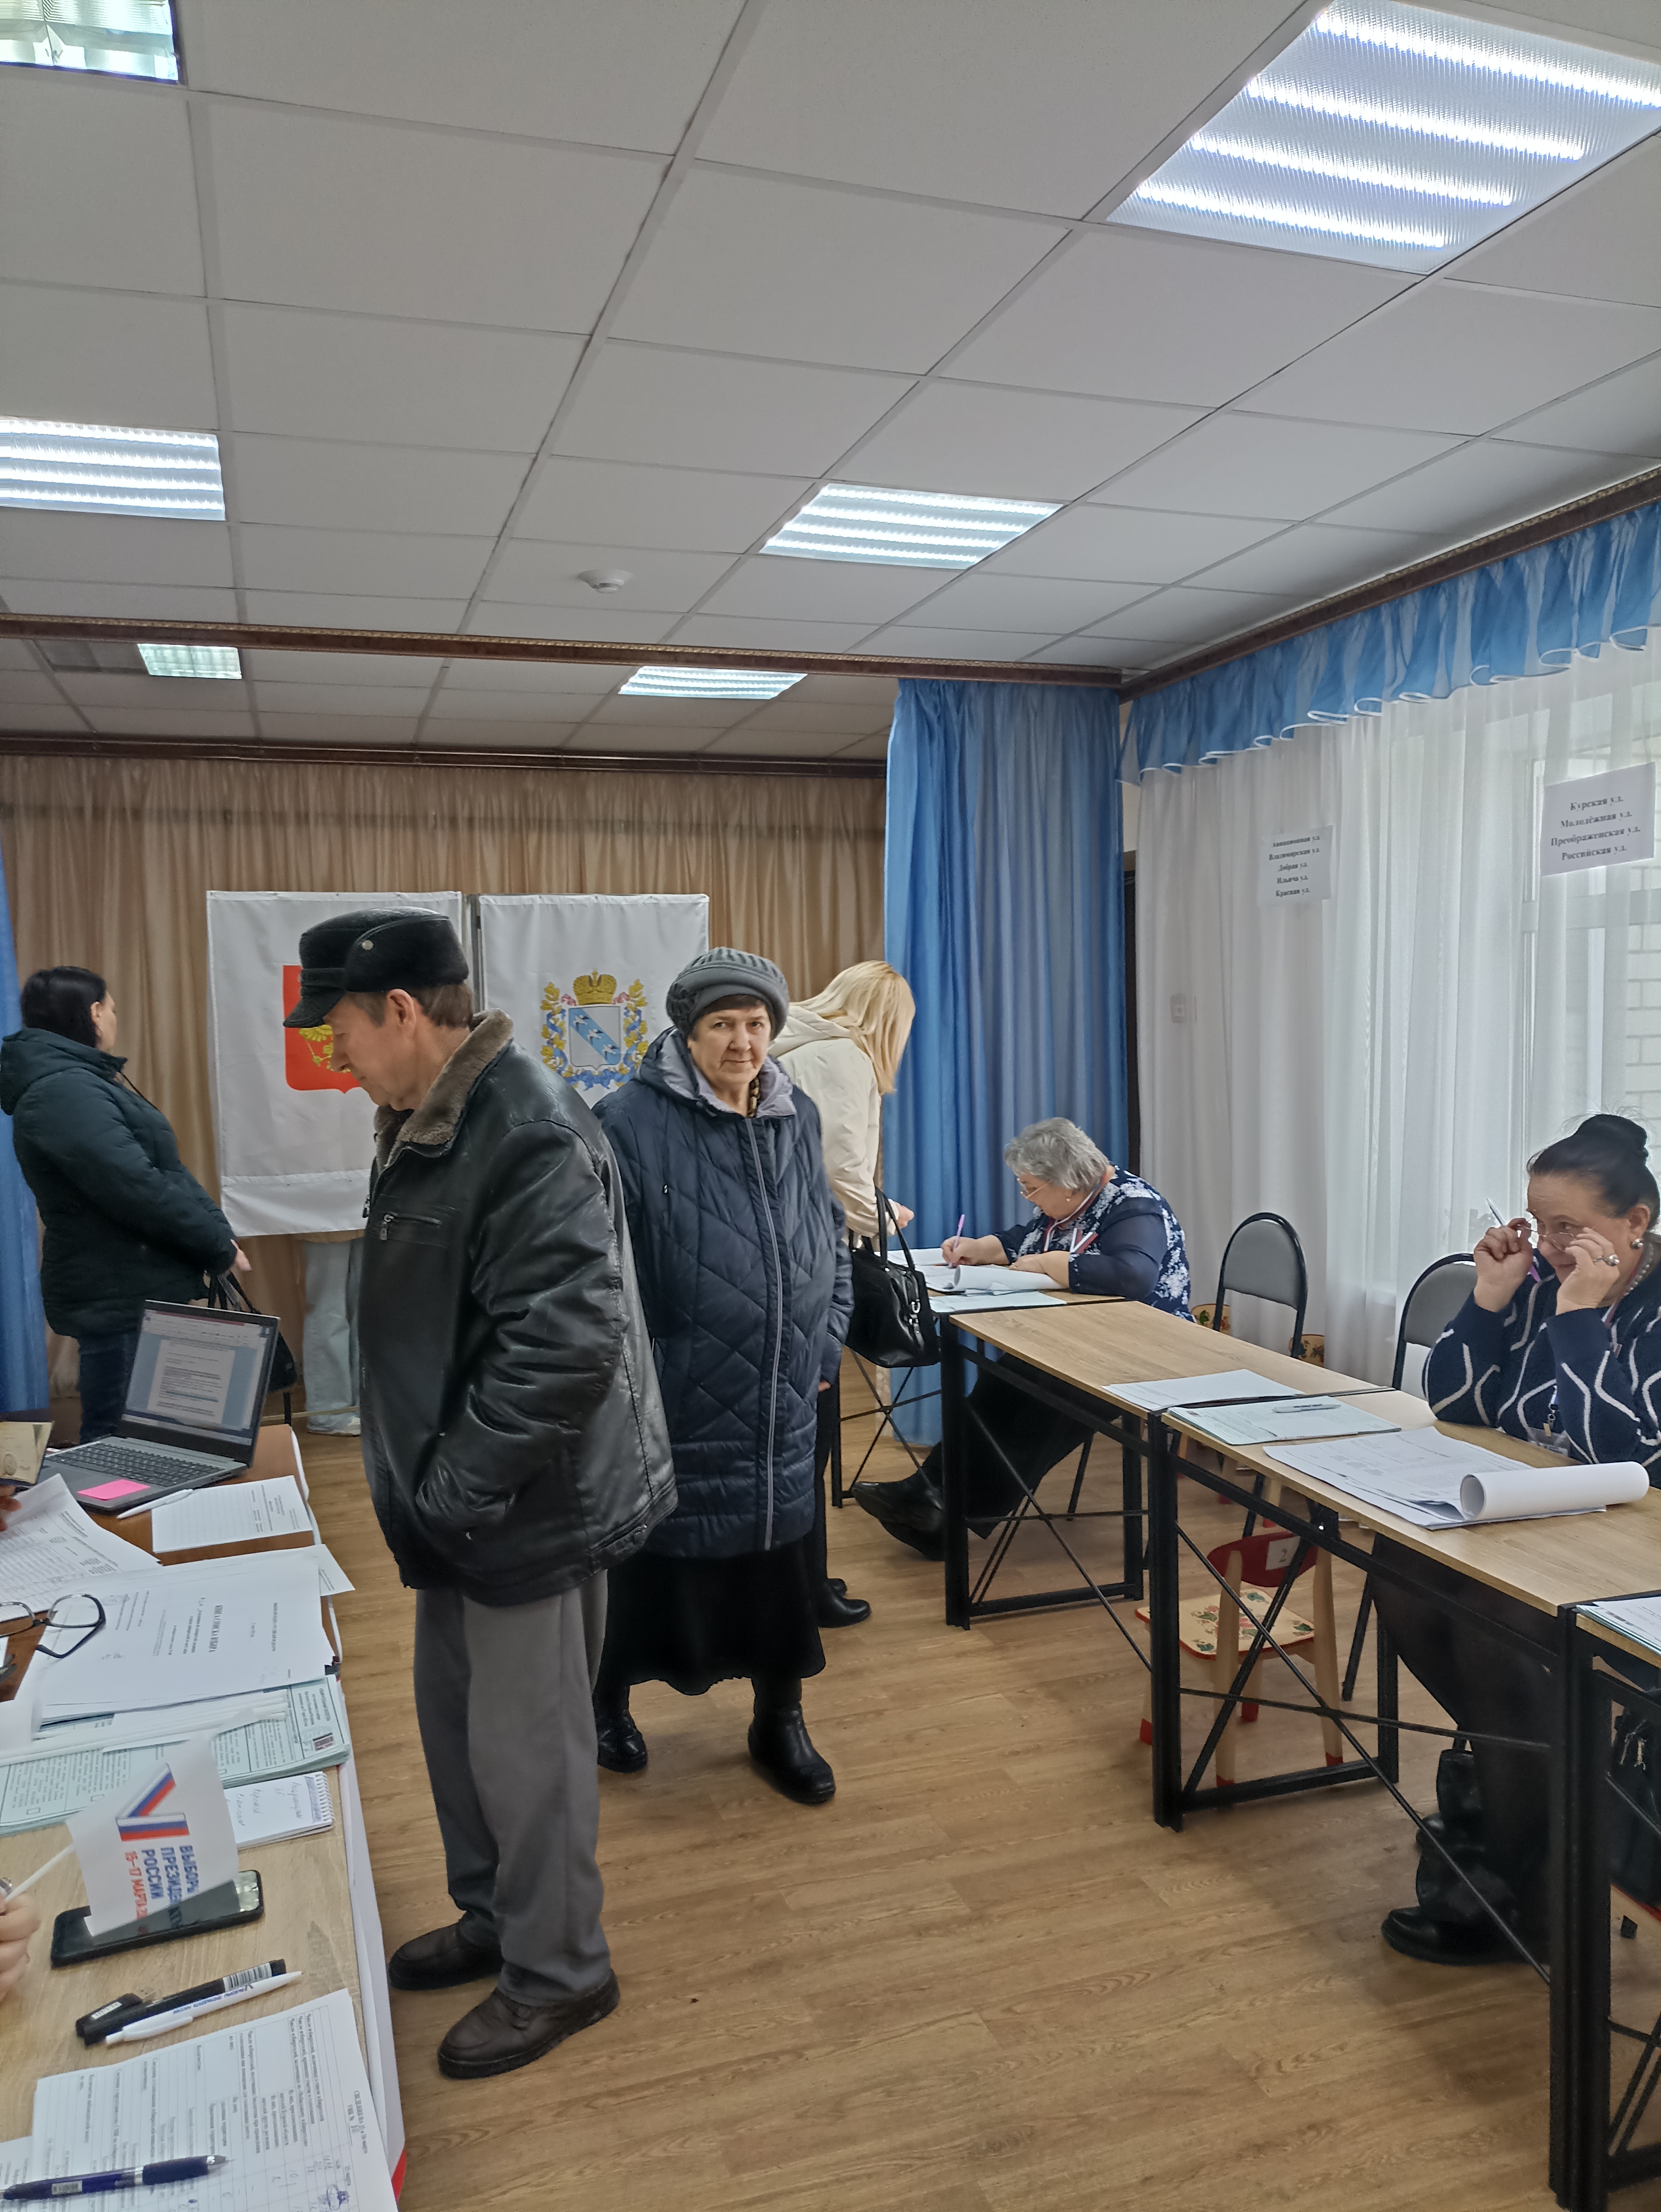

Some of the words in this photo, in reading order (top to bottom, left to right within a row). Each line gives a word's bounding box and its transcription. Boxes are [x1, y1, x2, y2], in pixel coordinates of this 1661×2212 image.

[1570, 798, 1607, 811] Курская
[1610, 796, 1624, 806] ул.
[1560, 814, 1617, 828] Молодёжная
[1618, 811, 1632, 821] ул.
[1551, 829, 1625, 847] Преображенская
[1627, 826, 1641, 836] ул.
[1561, 848, 1611, 861] Российская
[1614, 845, 1627, 855] ул.
[1279, 1548, 1287, 1563] 2
[141, 1848, 164, 1899] РОССИИ
[160, 1847, 183, 1929] ПРЕЗИДЕ
